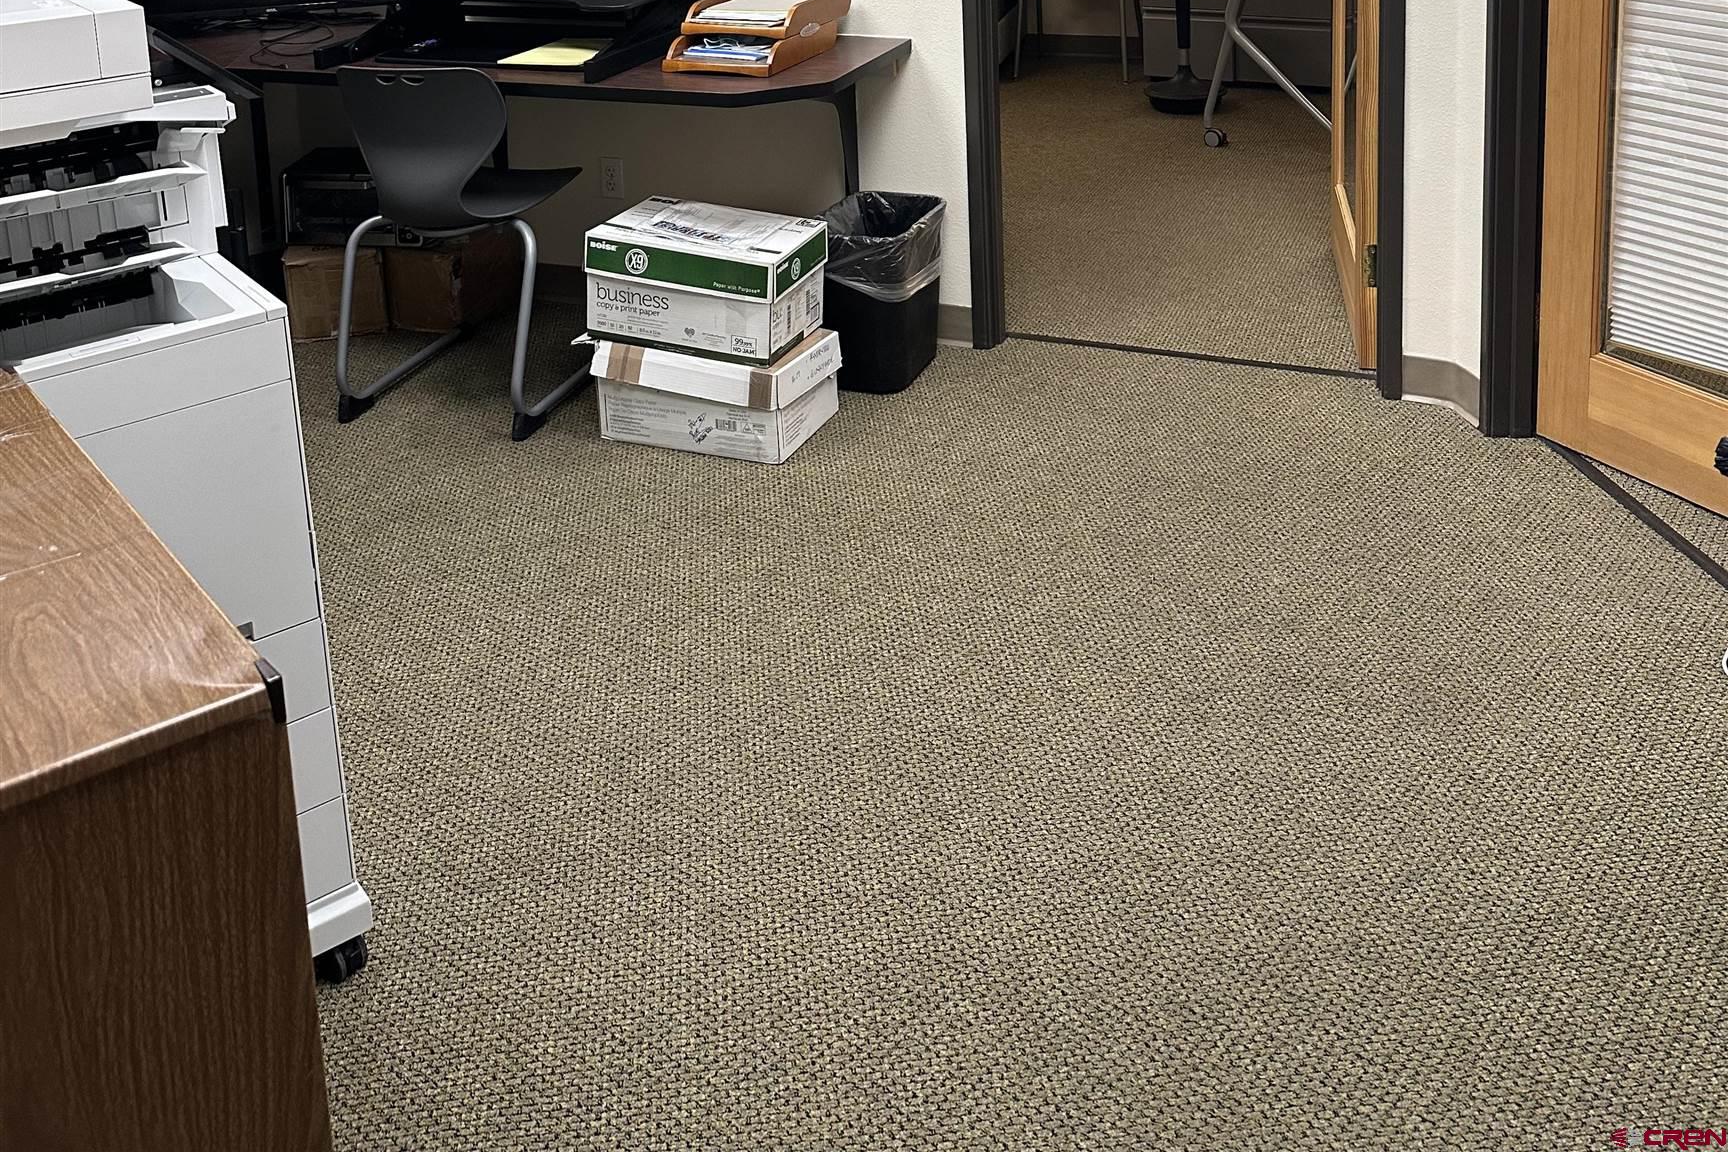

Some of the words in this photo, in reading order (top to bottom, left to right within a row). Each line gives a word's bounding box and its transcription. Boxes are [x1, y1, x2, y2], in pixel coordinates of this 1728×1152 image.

[630, 253, 644, 270] X9
[713, 281, 726, 289] Paper
[596, 282, 669, 310] business
[596, 301, 614, 312] copy
[620, 304, 638, 314] print
[639, 307, 661, 317] paper
